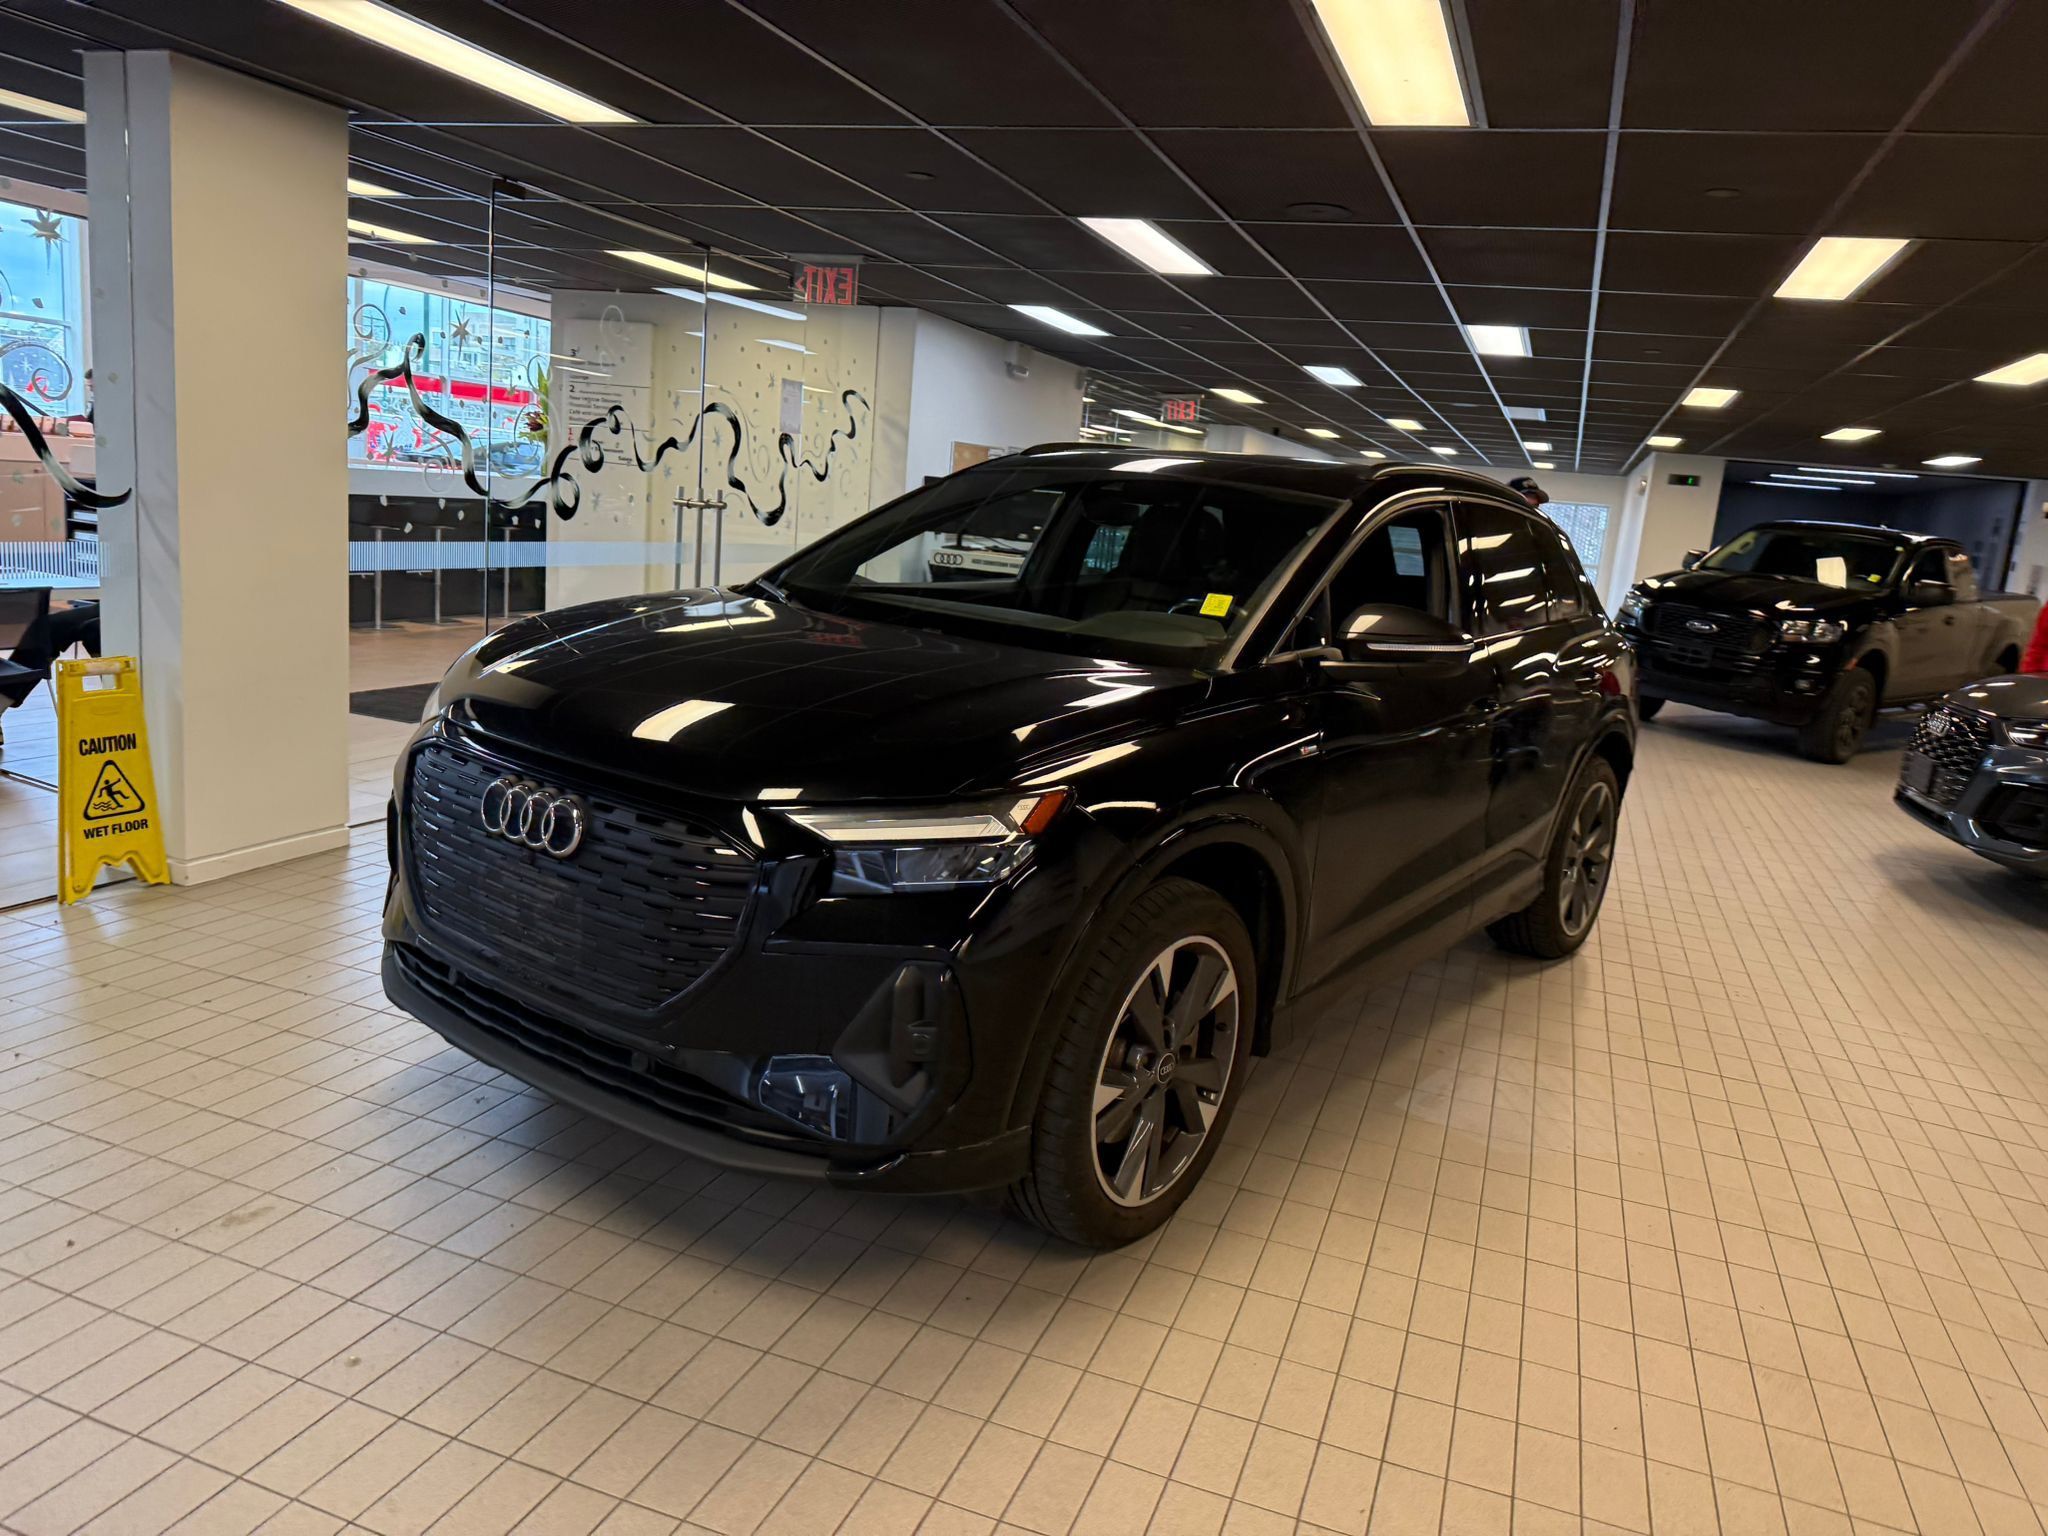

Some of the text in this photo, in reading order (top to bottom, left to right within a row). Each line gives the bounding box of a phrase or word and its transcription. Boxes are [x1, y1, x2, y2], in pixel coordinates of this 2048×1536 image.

[569, 384, 575, 393] 2
[79, 733, 137, 756] CAUTION
[83, 819, 149, 839] WET FLOOR
